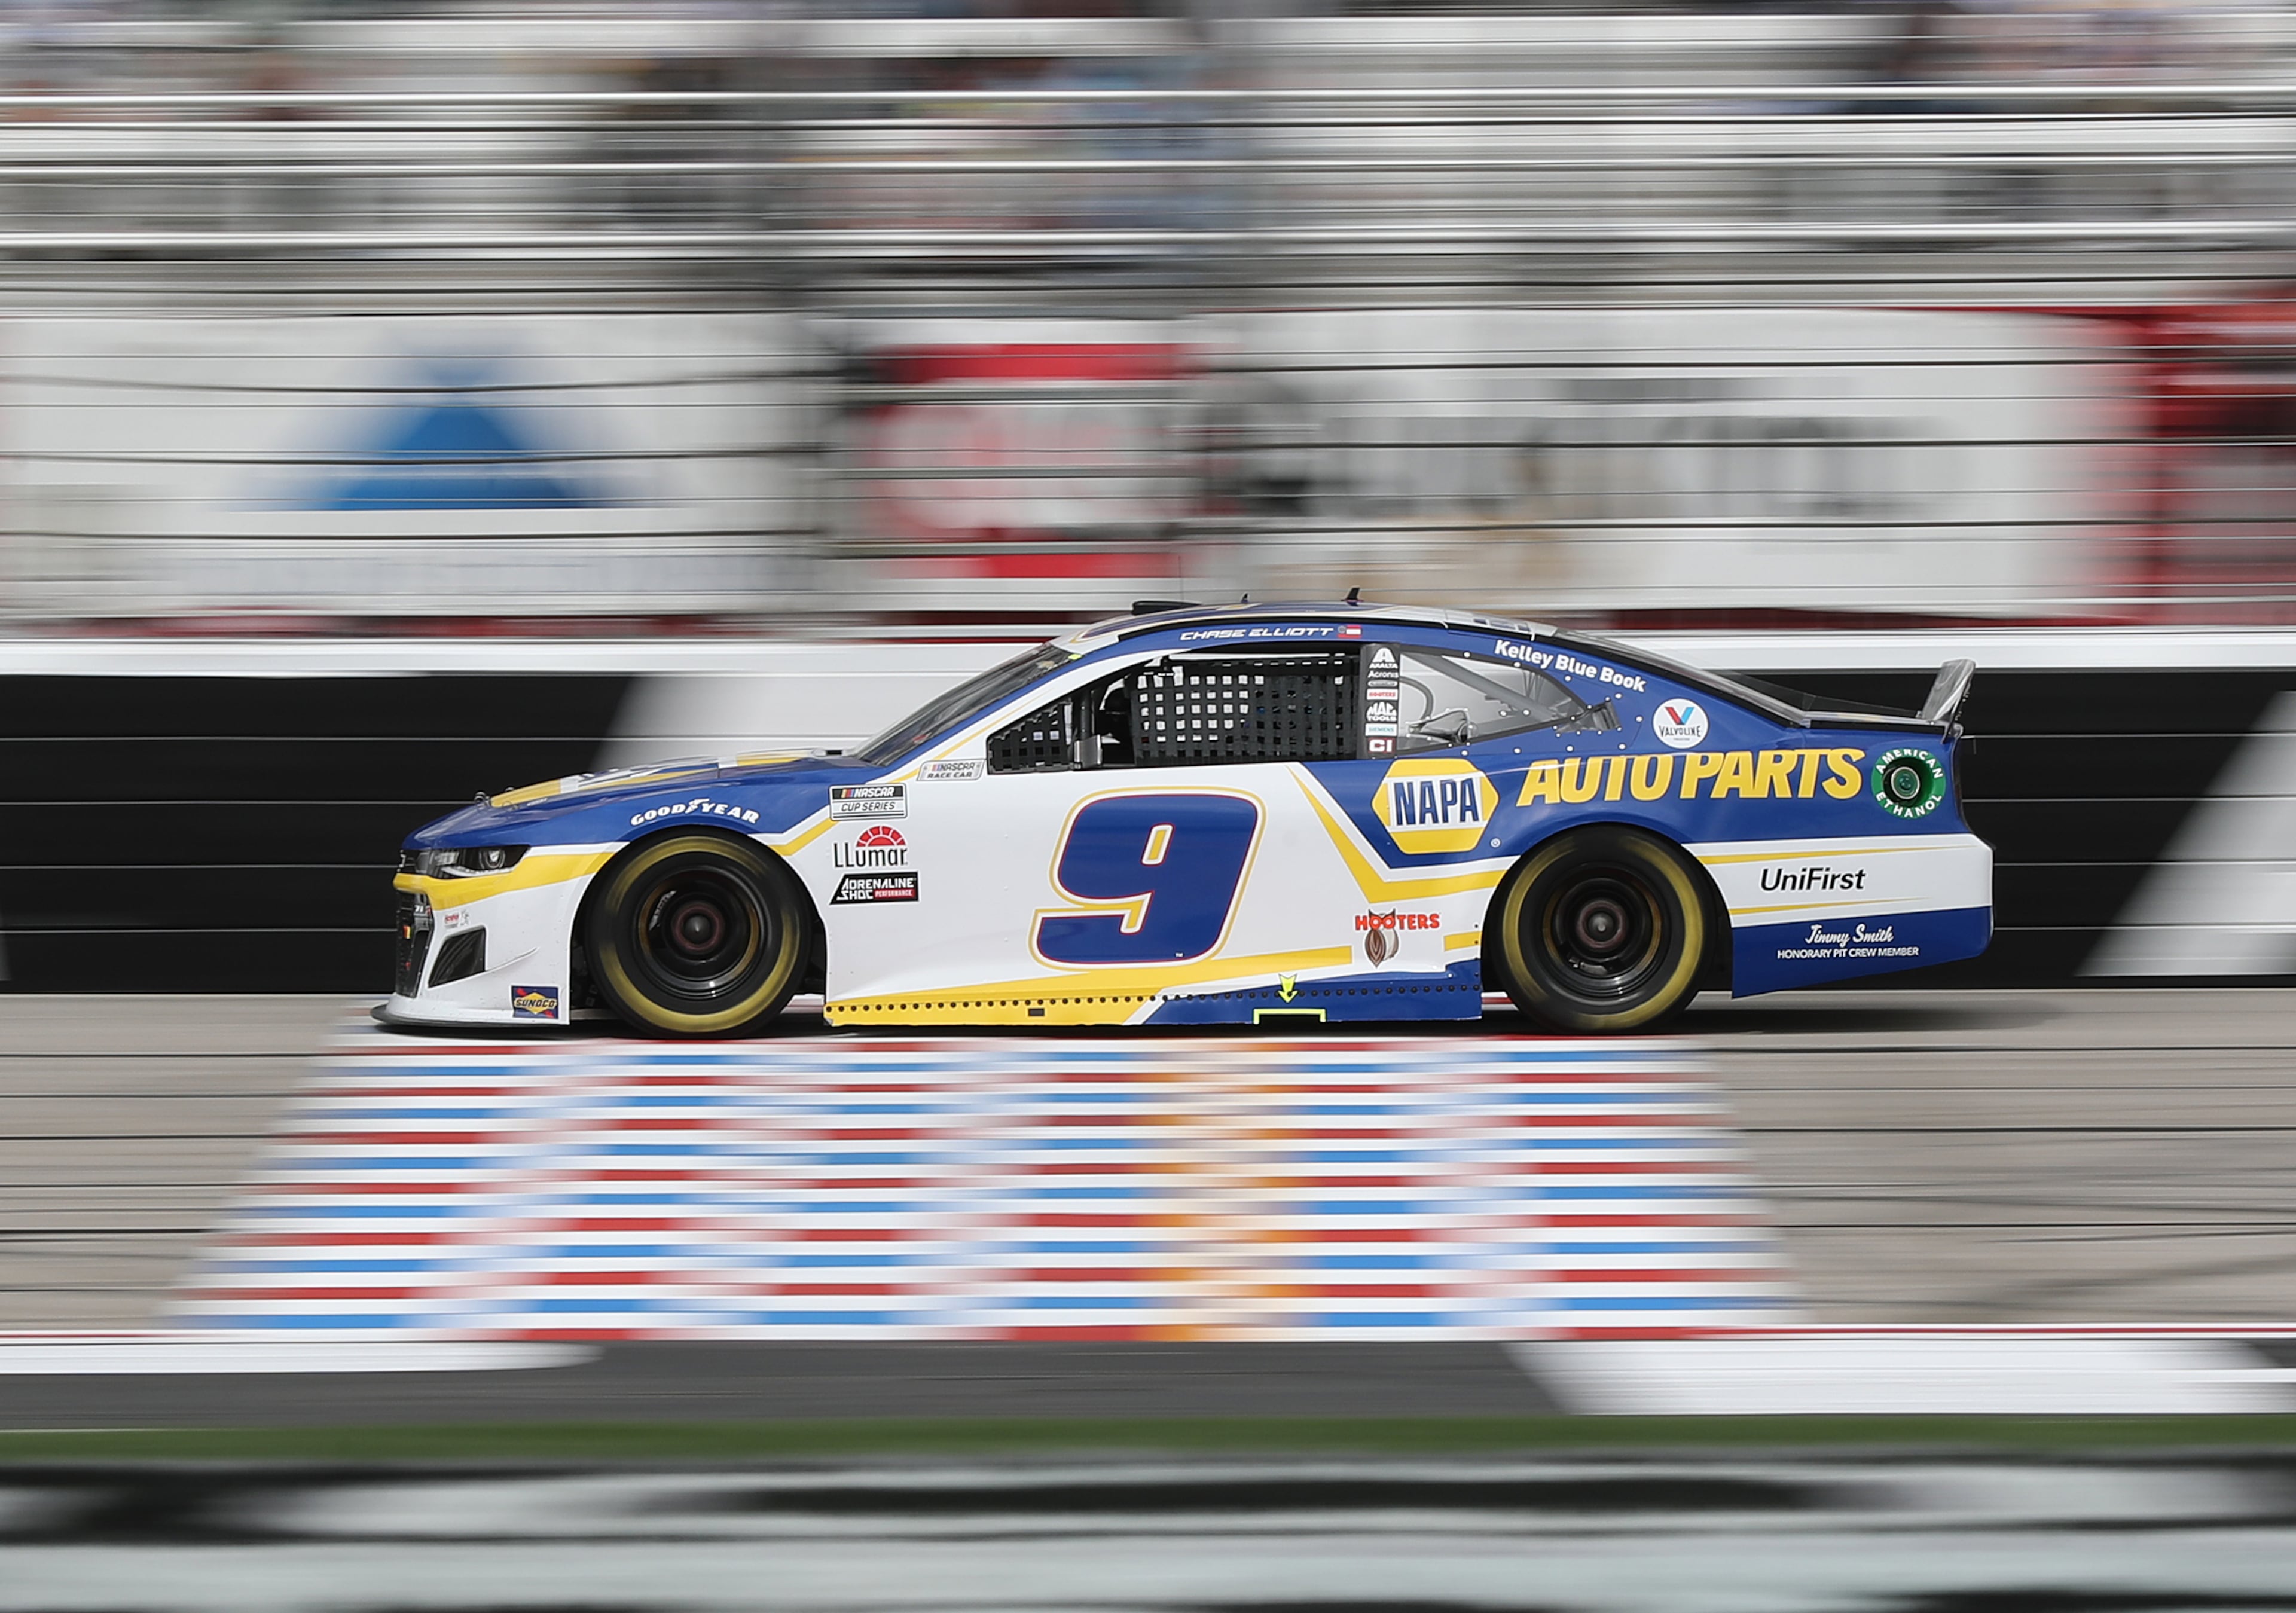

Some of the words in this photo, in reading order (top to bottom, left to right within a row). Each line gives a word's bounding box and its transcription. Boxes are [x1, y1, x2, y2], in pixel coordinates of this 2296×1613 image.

[1180, 629, 1246, 640] CHASE
[1248, 627, 1334, 637] ELLIOTT
[1495, 639, 1554, 669] Kelley
[1555, 655, 1597, 678] Blue
[1599, 667, 1646, 692] Book
[1367, 670, 1399, 679] Acronis
[1367, 701, 1397, 715] MAC
[1659, 725, 1701, 737] VALVOLINE
[941, 762, 975, 771] NASCAR
[1876, 749, 1943, 780] AMERICAN
[1516, 753, 1675, 806] AUTO
[1680, 748, 1866, 799] PARTS
[854, 787, 894, 798] NASCAR
[1394, 776, 1480, 826] NAPA
[630, 798, 759, 826] GOODYEAR
[841, 803, 860, 812] CUP
[862, 801, 895, 811] SERIES
[1876, 792, 1942, 818] ETHANOL
[834, 844, 907, 867] LLumar
[842, 877, 914, 890] ADRENALINE
[1028, 787, 1266, 972] 9
[1760, 867, 1866, 891] UniFirst
[875, 889, 912, 897] PERFORMANCE
[1355, 910, 1440, 931] HOOTERS
[1805, 924, 1850, 946] Jimmy
[1852, 924, 1894, 943] Smith
[1777, 949, 1831, 959] HONORARY
[1833, 948, 1847, 958] PIT
[1848, 948, 1877, 958] CREW
[1877, 946, 1919, 957] MEMBER
[515, 997, 557, 1010] SUNOCO
